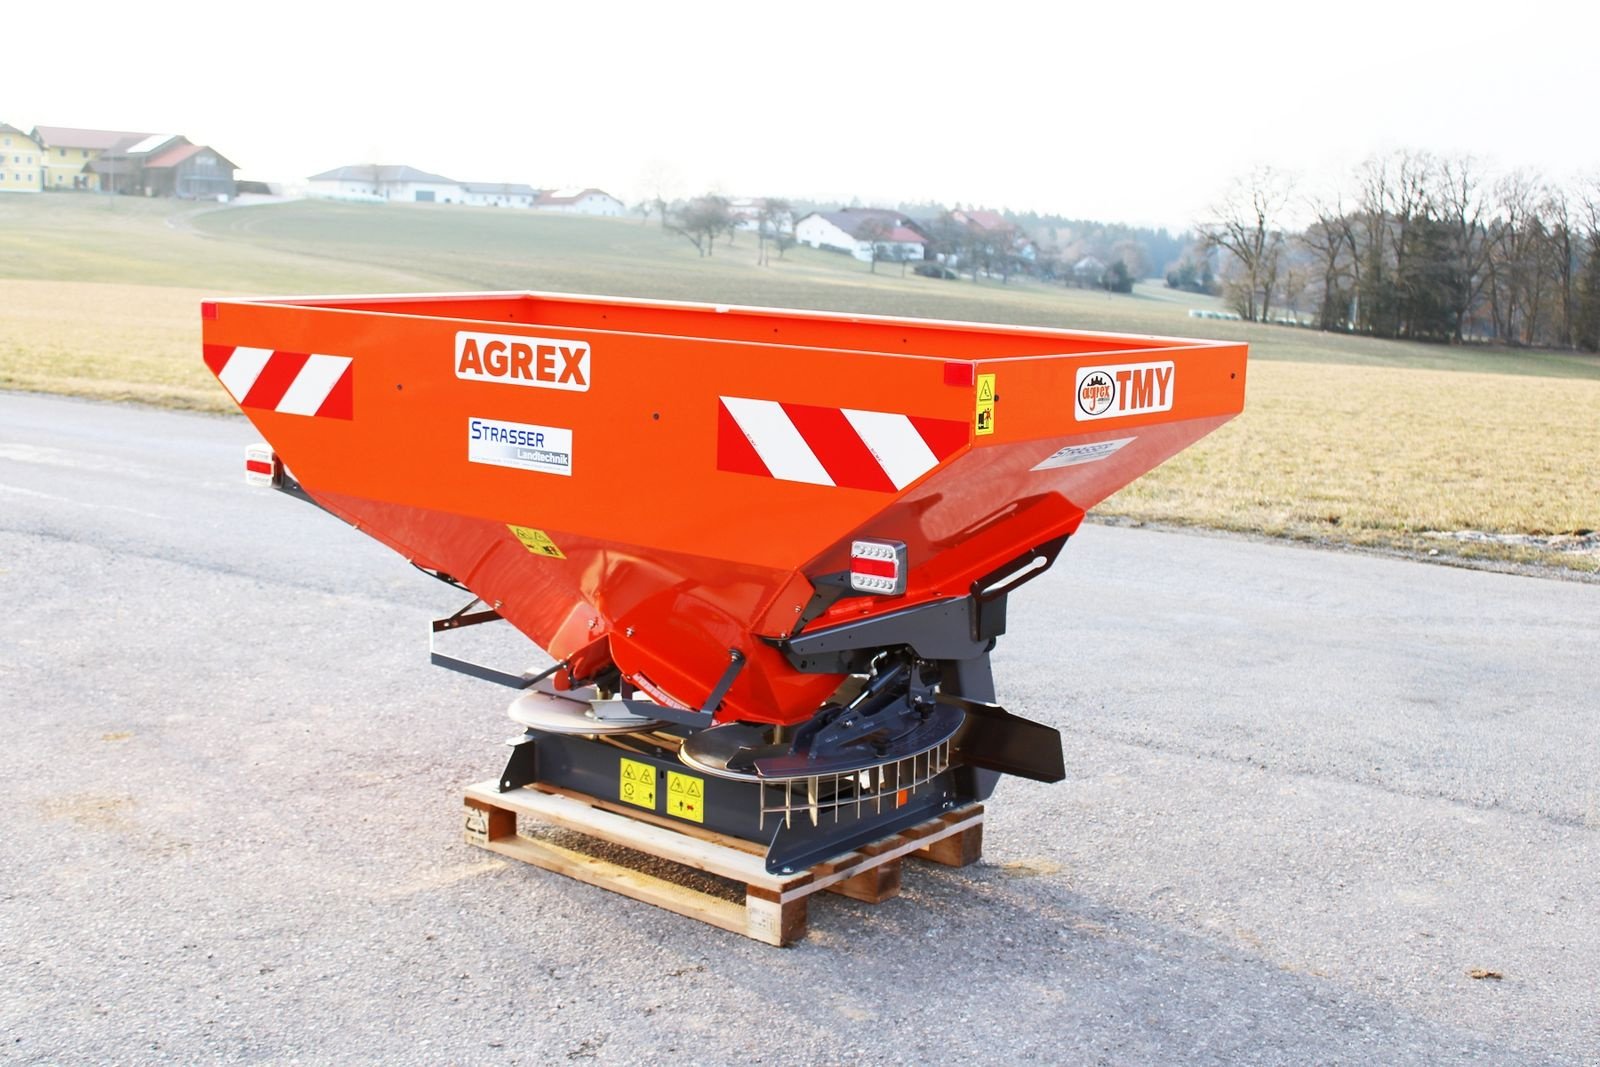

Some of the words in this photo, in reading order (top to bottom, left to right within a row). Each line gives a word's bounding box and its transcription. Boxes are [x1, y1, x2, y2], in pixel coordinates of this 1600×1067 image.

[458, 338, 587, 386] AGREX
[1115, 366, 1173, 411] TMY
[471, 420, 545, 448] STRASSER
[517, 448, 569, 466] Landtechnik
